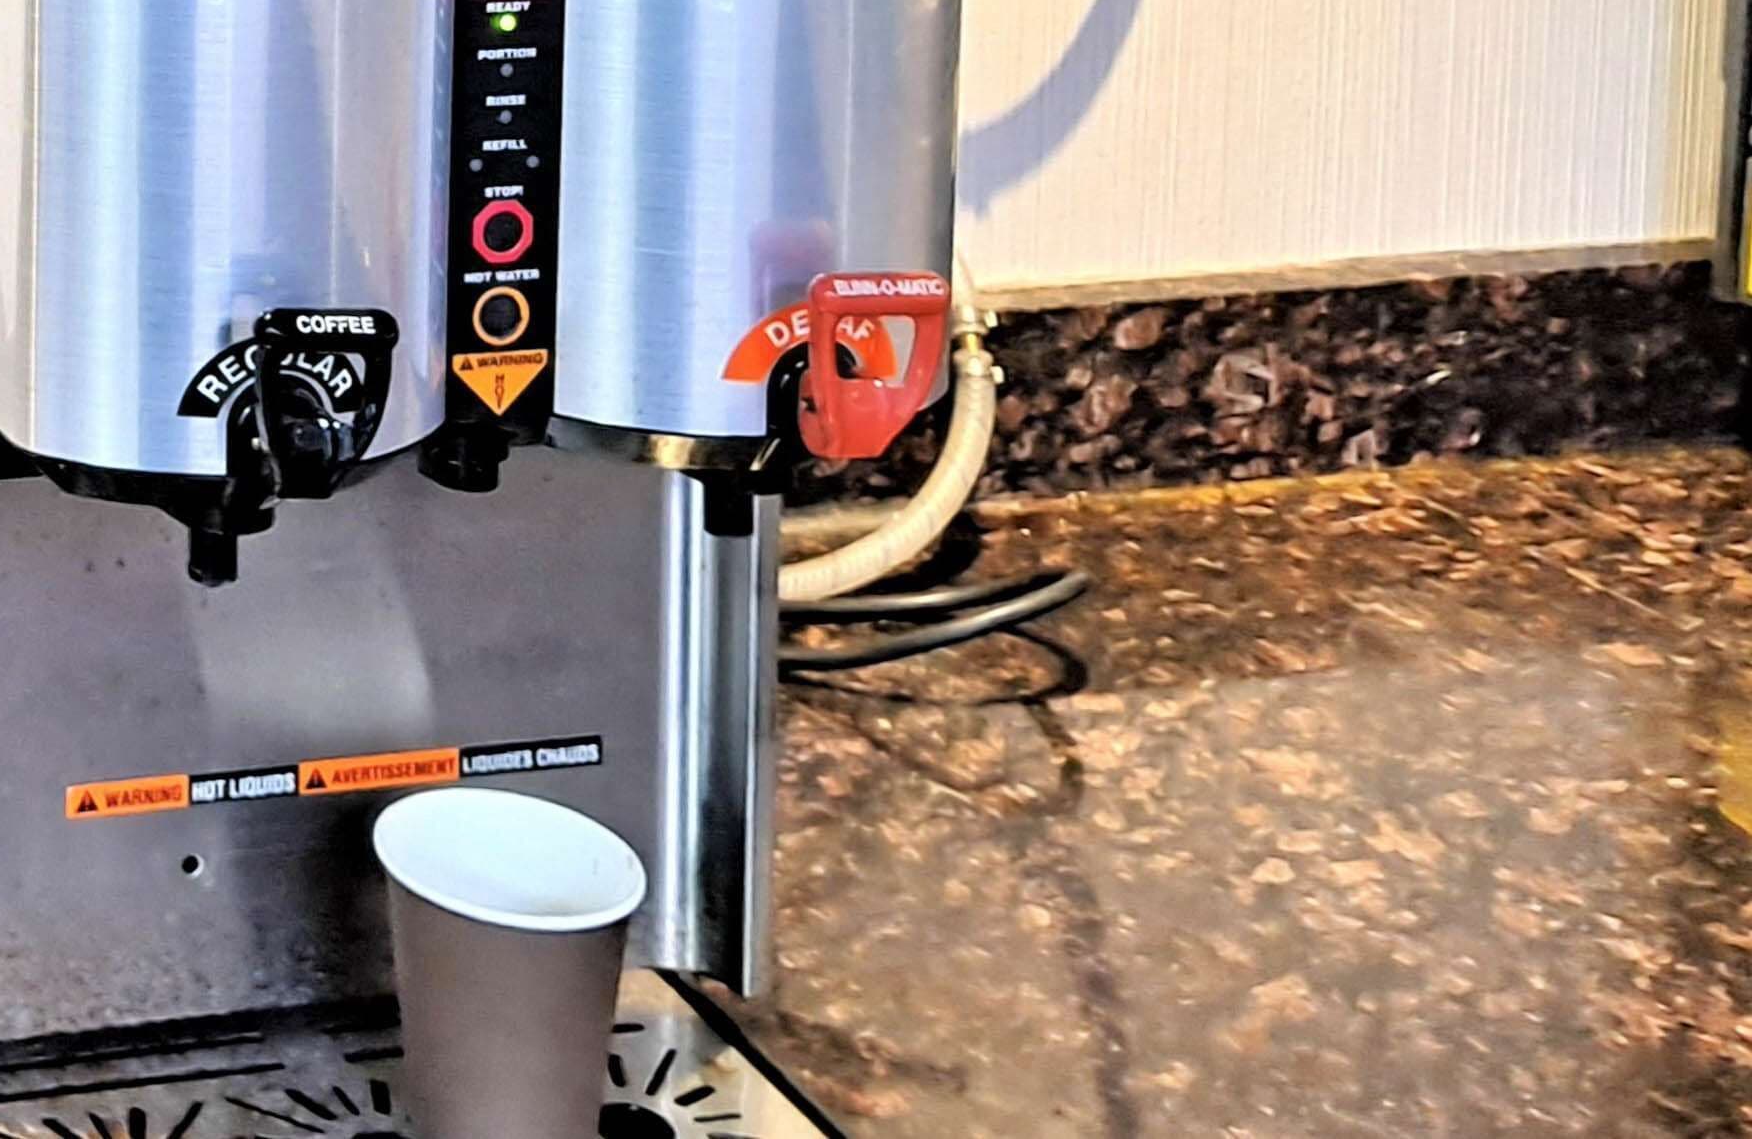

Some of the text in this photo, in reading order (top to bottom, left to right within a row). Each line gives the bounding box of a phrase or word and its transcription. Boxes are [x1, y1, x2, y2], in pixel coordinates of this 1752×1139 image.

[486, 1, 531, 13] READY
[477, 47, 537, 61] PORTION
[482, 139, 528, 151] REFILL
[463, 269, 540, 283] HOT WATER
[296, 315, 377, 335] COFFEE
[765, 309, 875, 348] DEAF
[476, 352, 544, 368] WARNING
[197, 345, 353, 404] RELAR
[104, 783, 182, 808] WARNING
[191, 779, 225, 802] HOT
[229, 772, 296, 799] LIQUIDS
[331, 756, 457, 785] AVERTISSEMENT
